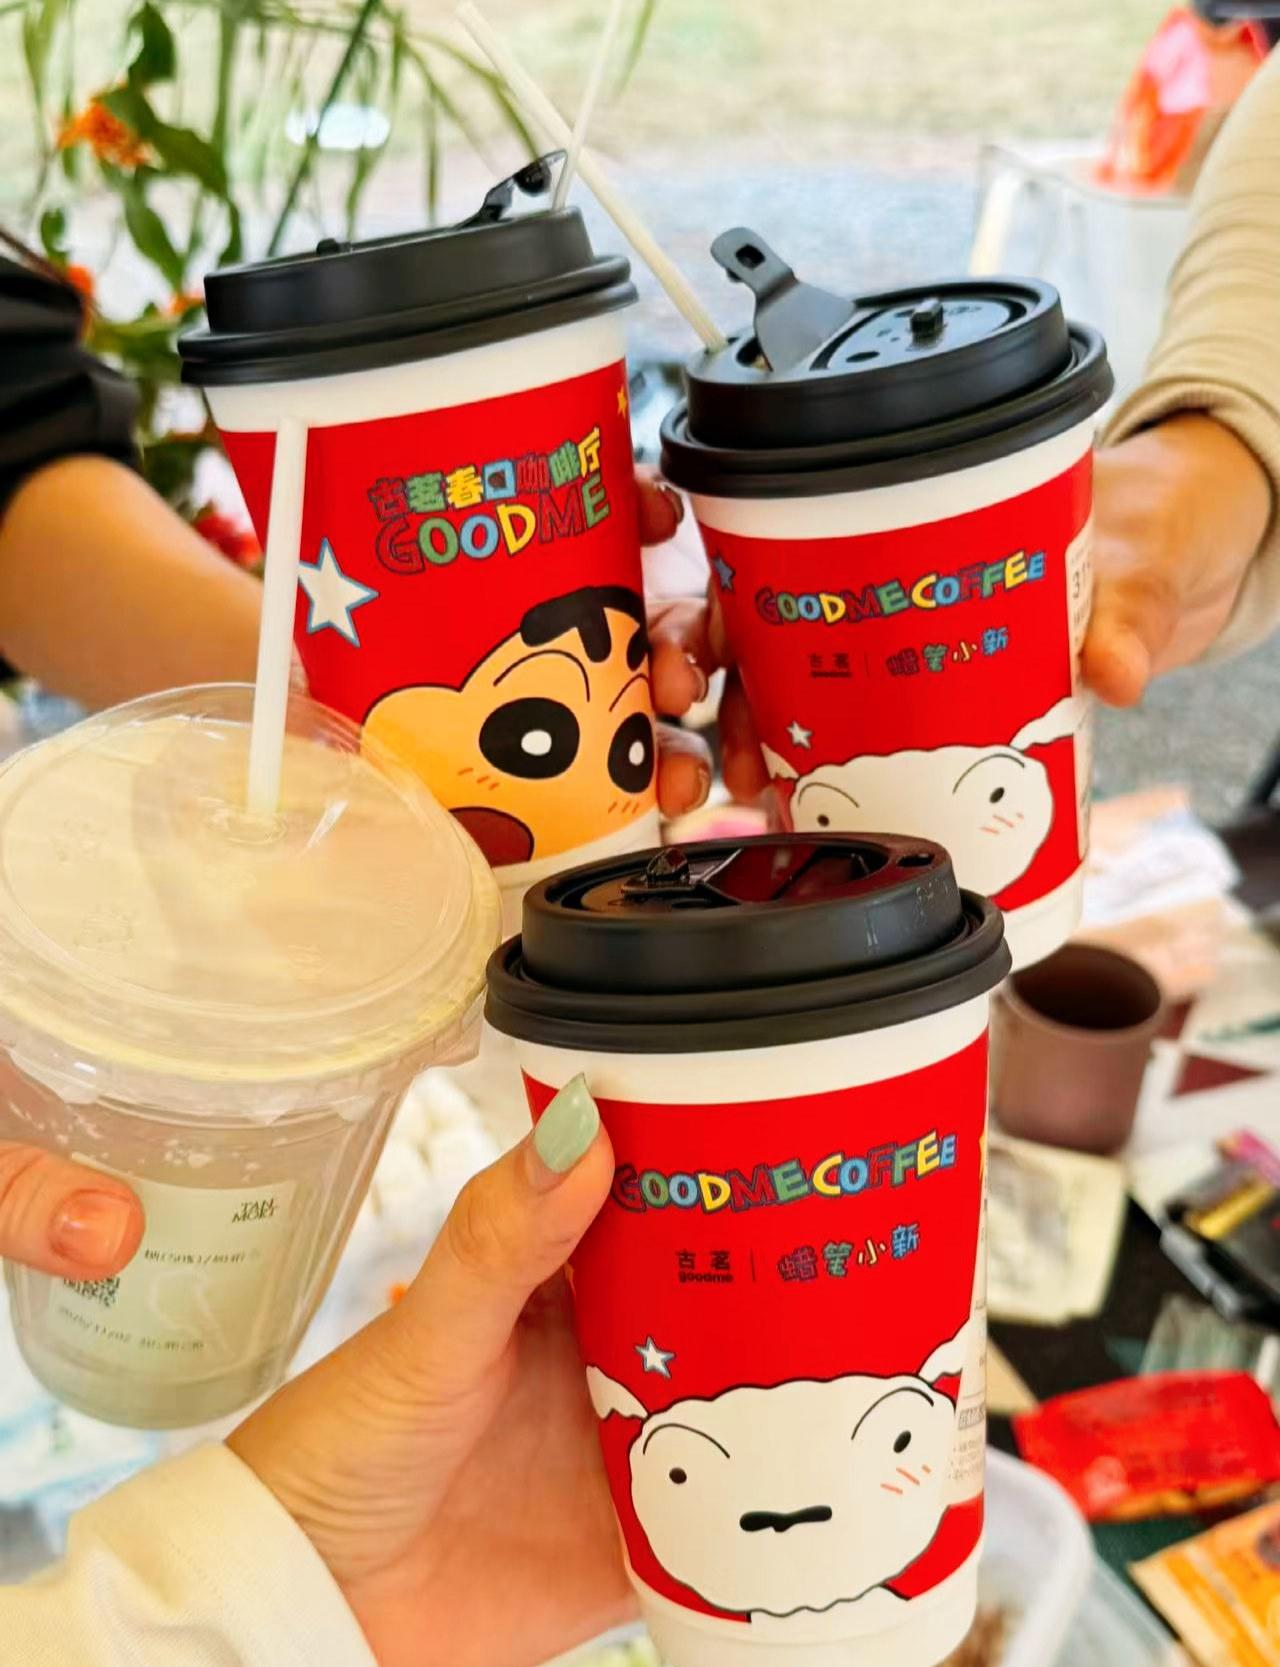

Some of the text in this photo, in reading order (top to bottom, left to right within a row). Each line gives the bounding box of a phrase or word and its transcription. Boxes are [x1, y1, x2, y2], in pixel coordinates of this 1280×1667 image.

[375, 472, 611, 575] GOODME
[778, 1223, 921, 1281] 蜡笔小新
